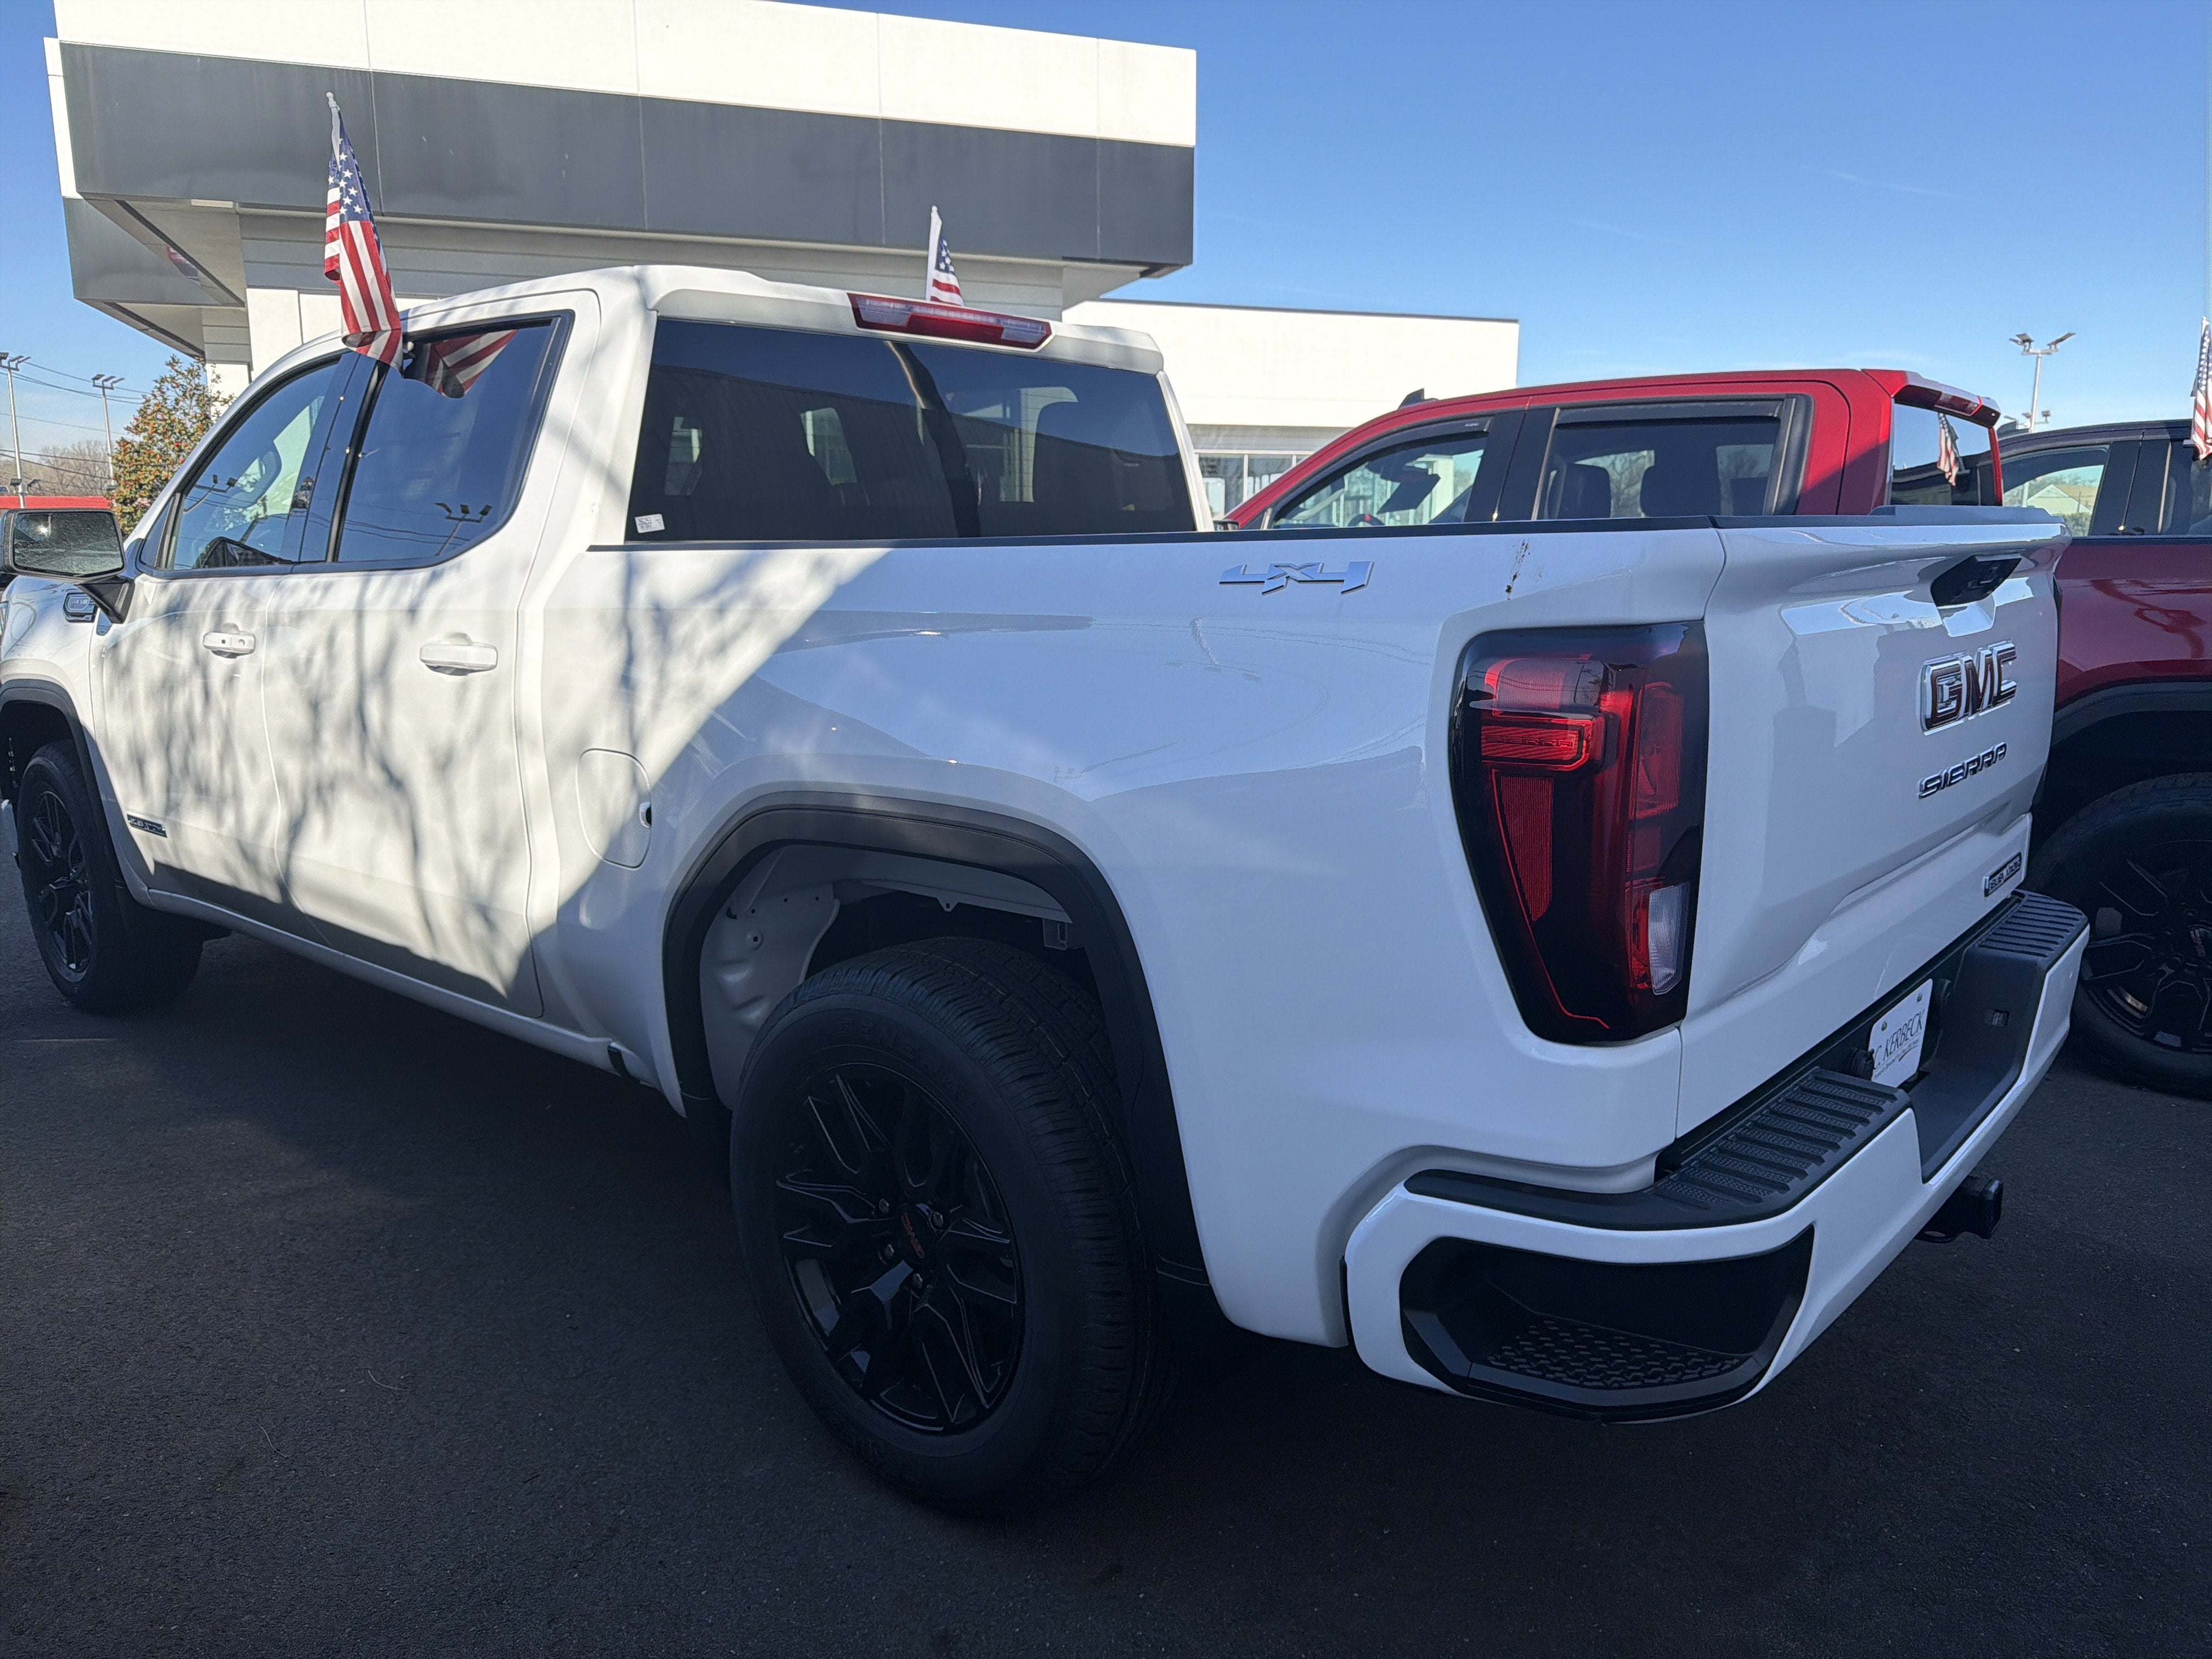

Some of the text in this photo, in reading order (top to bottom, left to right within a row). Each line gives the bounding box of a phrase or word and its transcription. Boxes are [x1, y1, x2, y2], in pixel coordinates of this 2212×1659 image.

[1920, 642, 2017, 732] GMC
[1918, 742, 2007, 799] SIERRA
[1883, 1009, 1926, 1062] KERBECK
